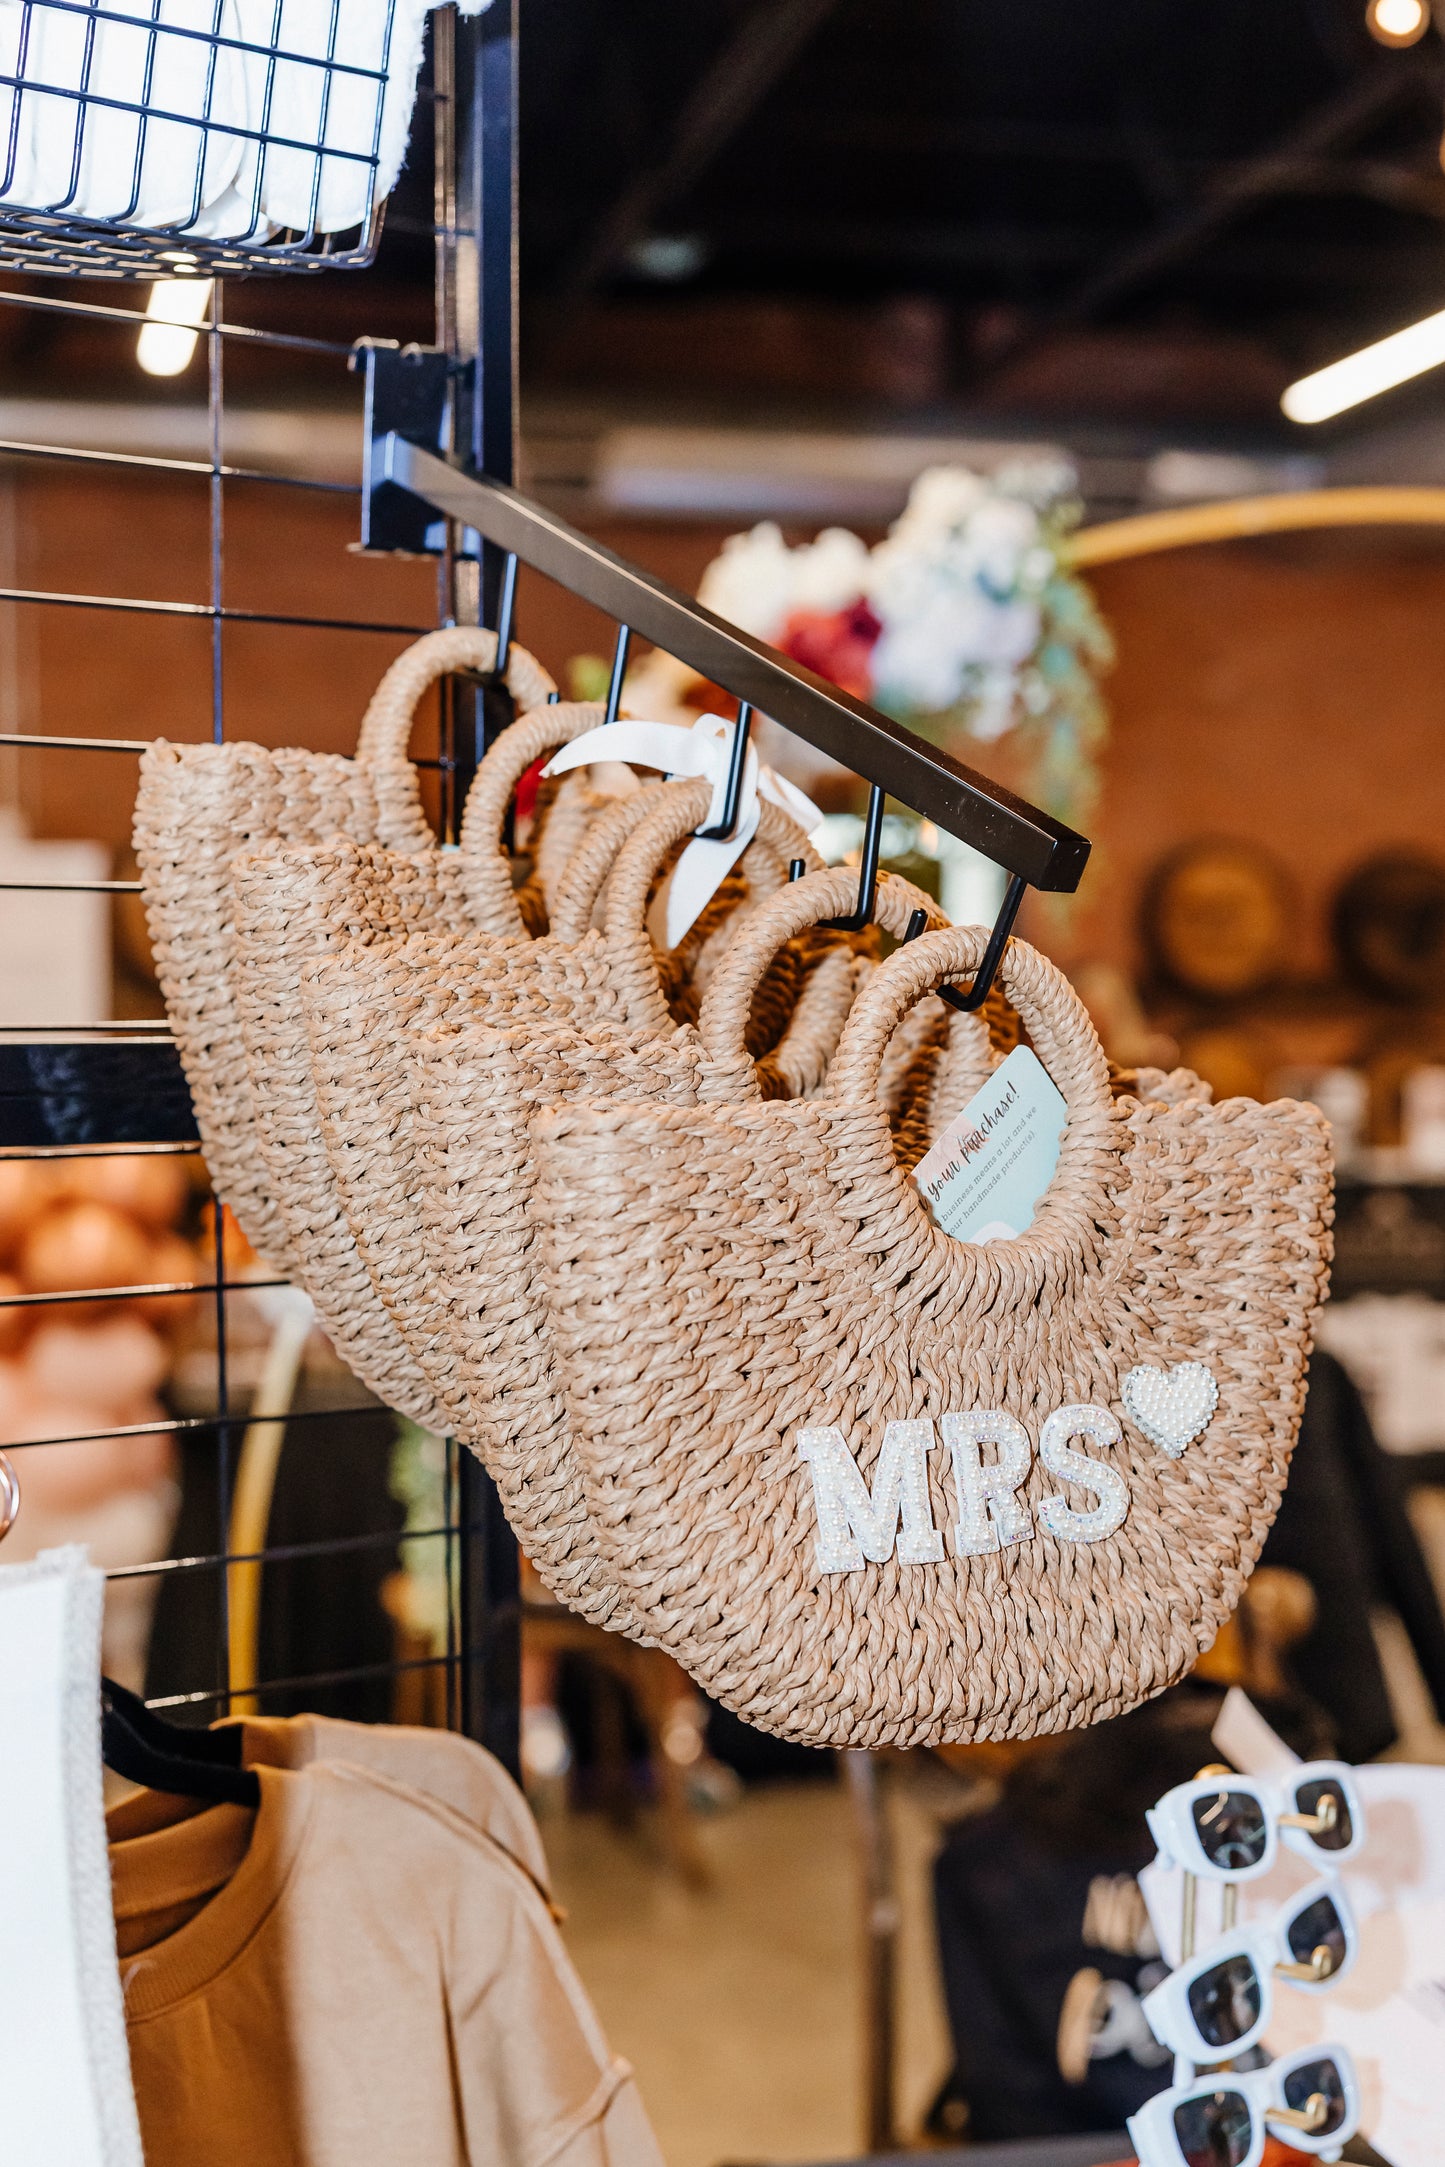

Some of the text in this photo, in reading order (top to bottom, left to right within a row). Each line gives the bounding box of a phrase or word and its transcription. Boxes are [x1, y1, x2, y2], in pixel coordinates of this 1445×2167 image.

[928, 1080, 1019, 1202] your purchase!
[941, 1184, 974, 1222] business
[973, 1154, 998, 1185] means
[1001, 1136, 1013, 1150] lot
[1012, 1118, 1026, 1137] and
[1026, 1106, 1037, 1120] we
[962, 1173, 1001, 1219] handmade
[796, 1403, 1130, 1575] MRS
